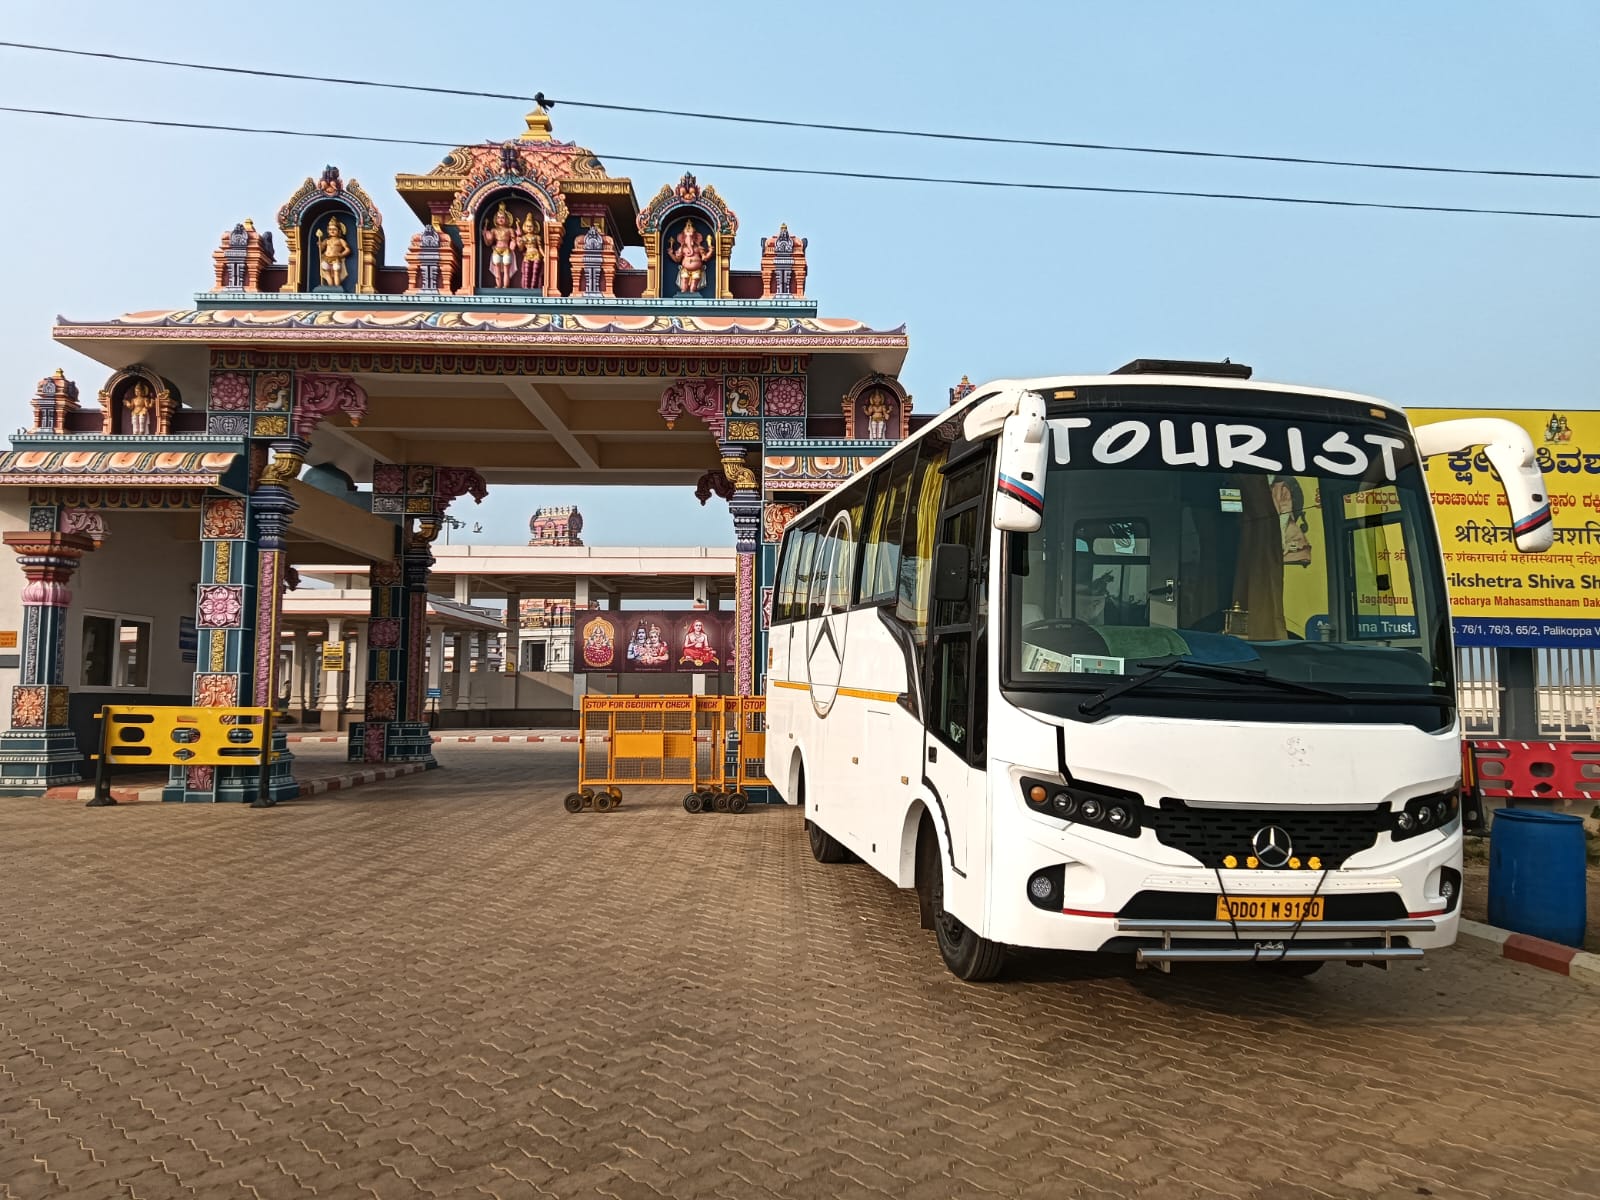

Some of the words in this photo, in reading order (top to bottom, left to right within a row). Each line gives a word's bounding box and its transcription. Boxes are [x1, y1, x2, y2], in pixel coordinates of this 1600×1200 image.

[1047, 416, 1405, 481] TOURIST
[1528, 574, 1575, 589] Shiva
[1359, 594, 1409, 607] Jagadguru
[1494, 596, 1580, 608] Mahasamsthanam
[1380, 620, 1416, 635] Trust,
[1461, 624, 1486, 636] 76/1,
[1515, 625, 1540, 637] 65/2,
[1543, 625, 1593, 638] Palikoppa
[586, 700, 608, 709] STOP
[609, 700, 624, 709] FOR
[625, 700, 664, 709] SECURITY
[665, 700, 690, 709] CHECK
[744, 700, 765, 710] STOP
